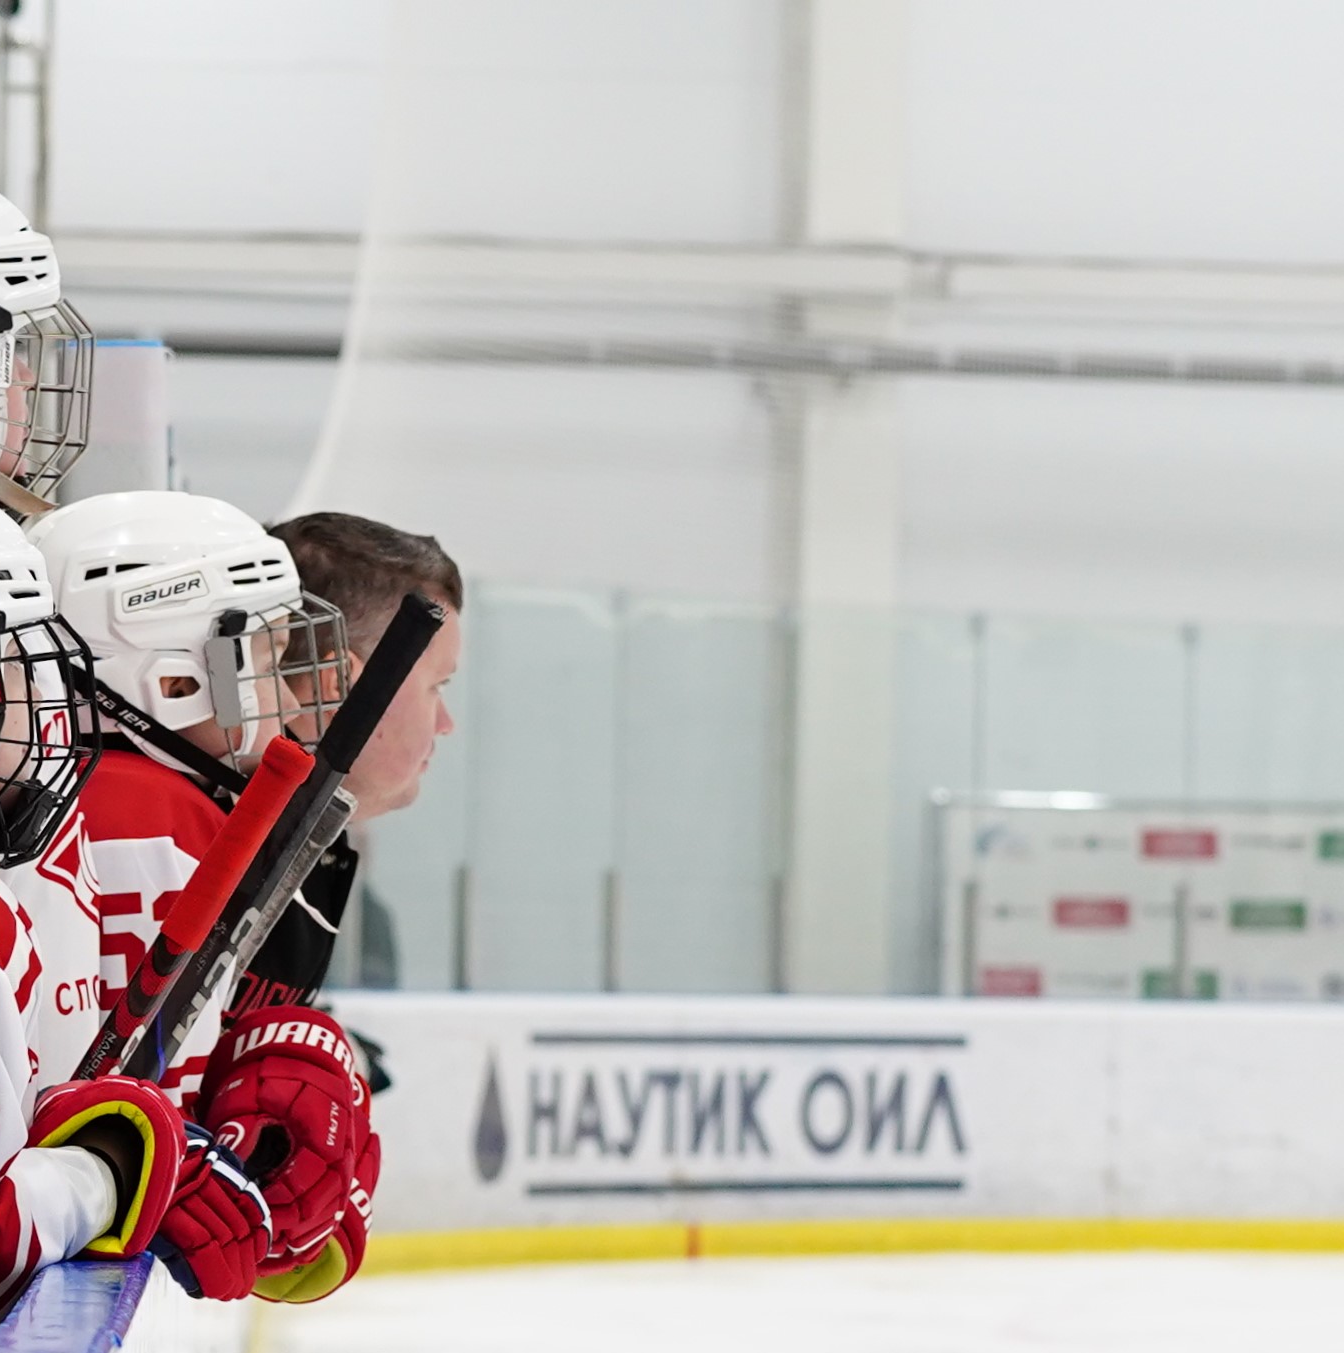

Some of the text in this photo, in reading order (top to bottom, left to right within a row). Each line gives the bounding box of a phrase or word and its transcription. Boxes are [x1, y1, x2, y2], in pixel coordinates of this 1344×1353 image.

[127, 578, 201, 608] BAUER
[525, 1068, 969, 1161] НАУТИК ОИЛ
